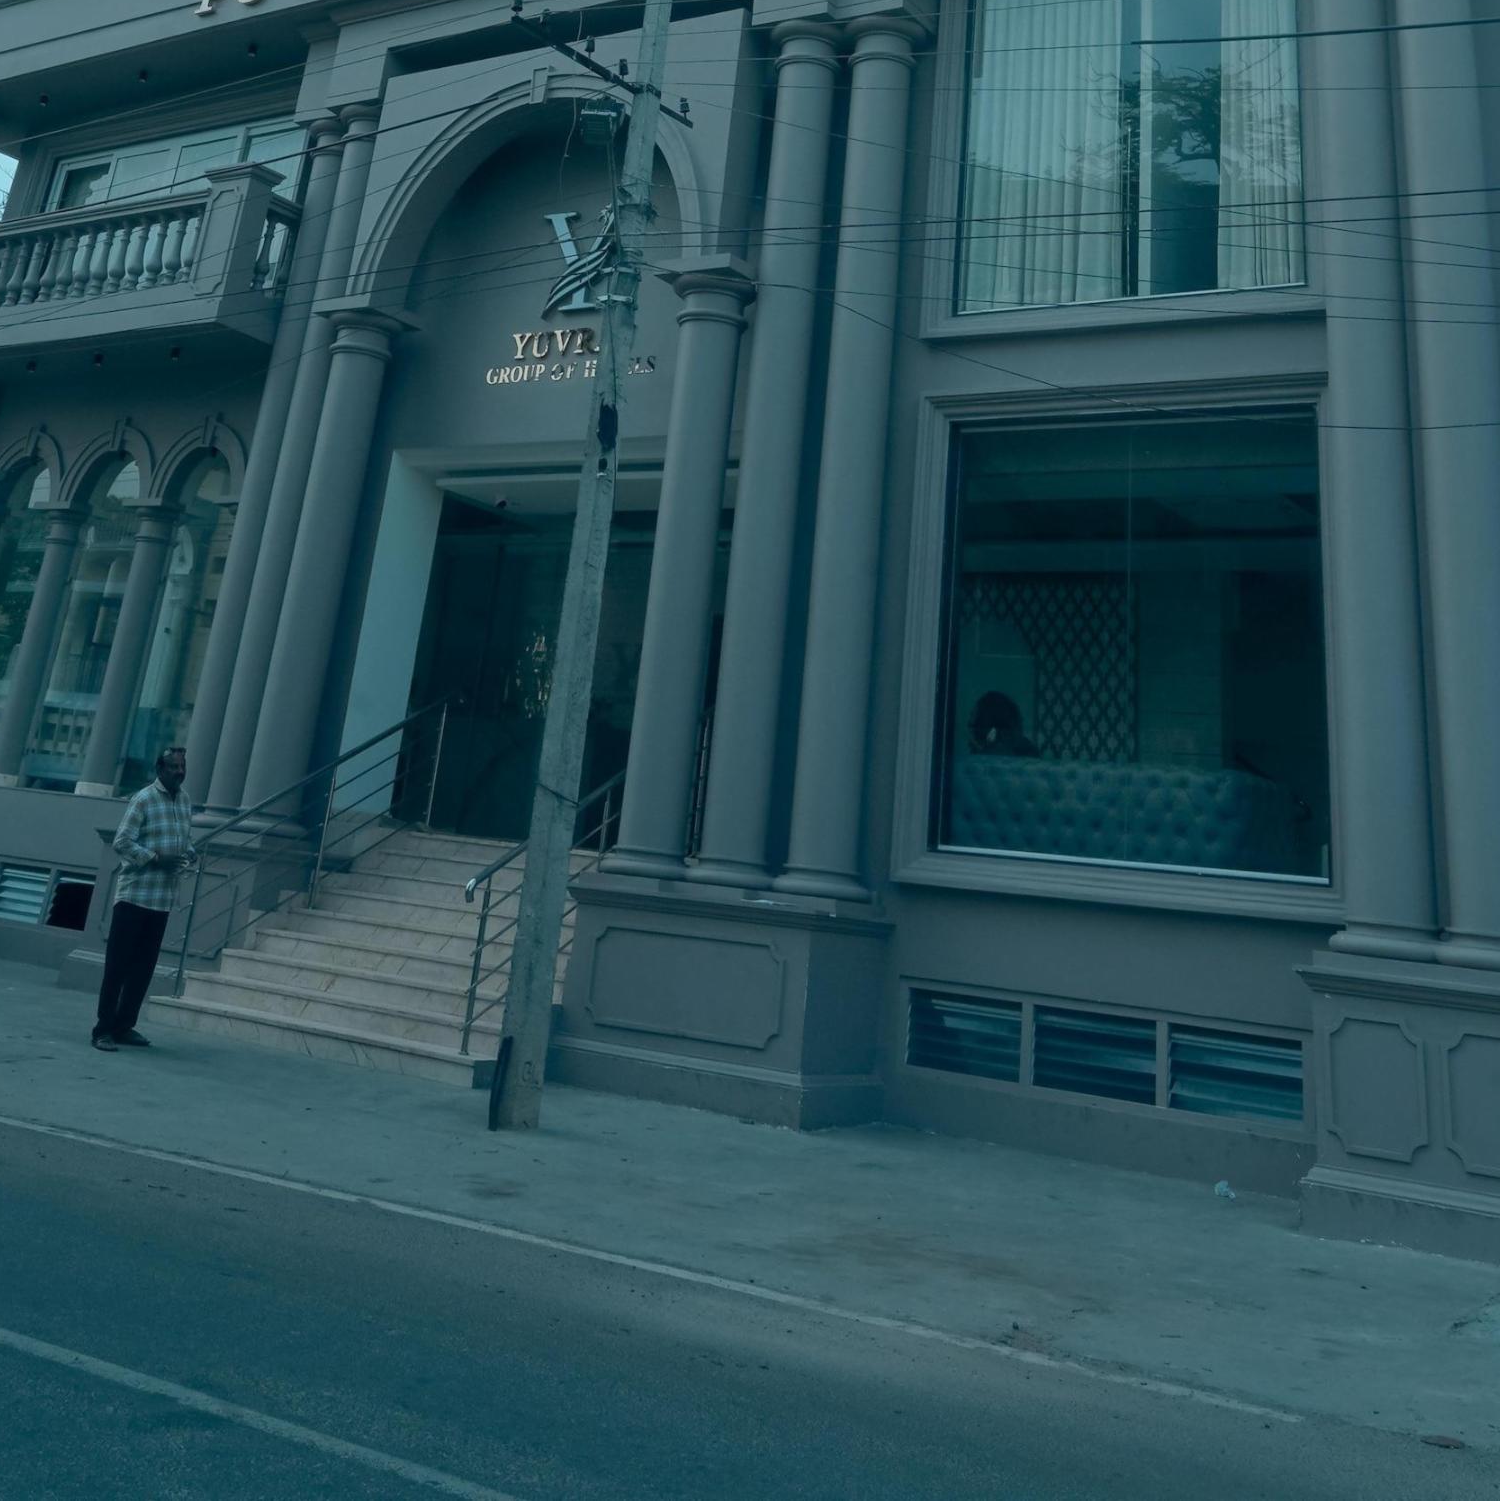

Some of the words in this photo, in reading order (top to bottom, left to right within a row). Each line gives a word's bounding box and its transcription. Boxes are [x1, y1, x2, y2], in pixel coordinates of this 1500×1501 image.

[512, 327, 601, 361] YUVR
[486, 363, 546, 386] GROUP
[550, 361, 578, 381] OF
